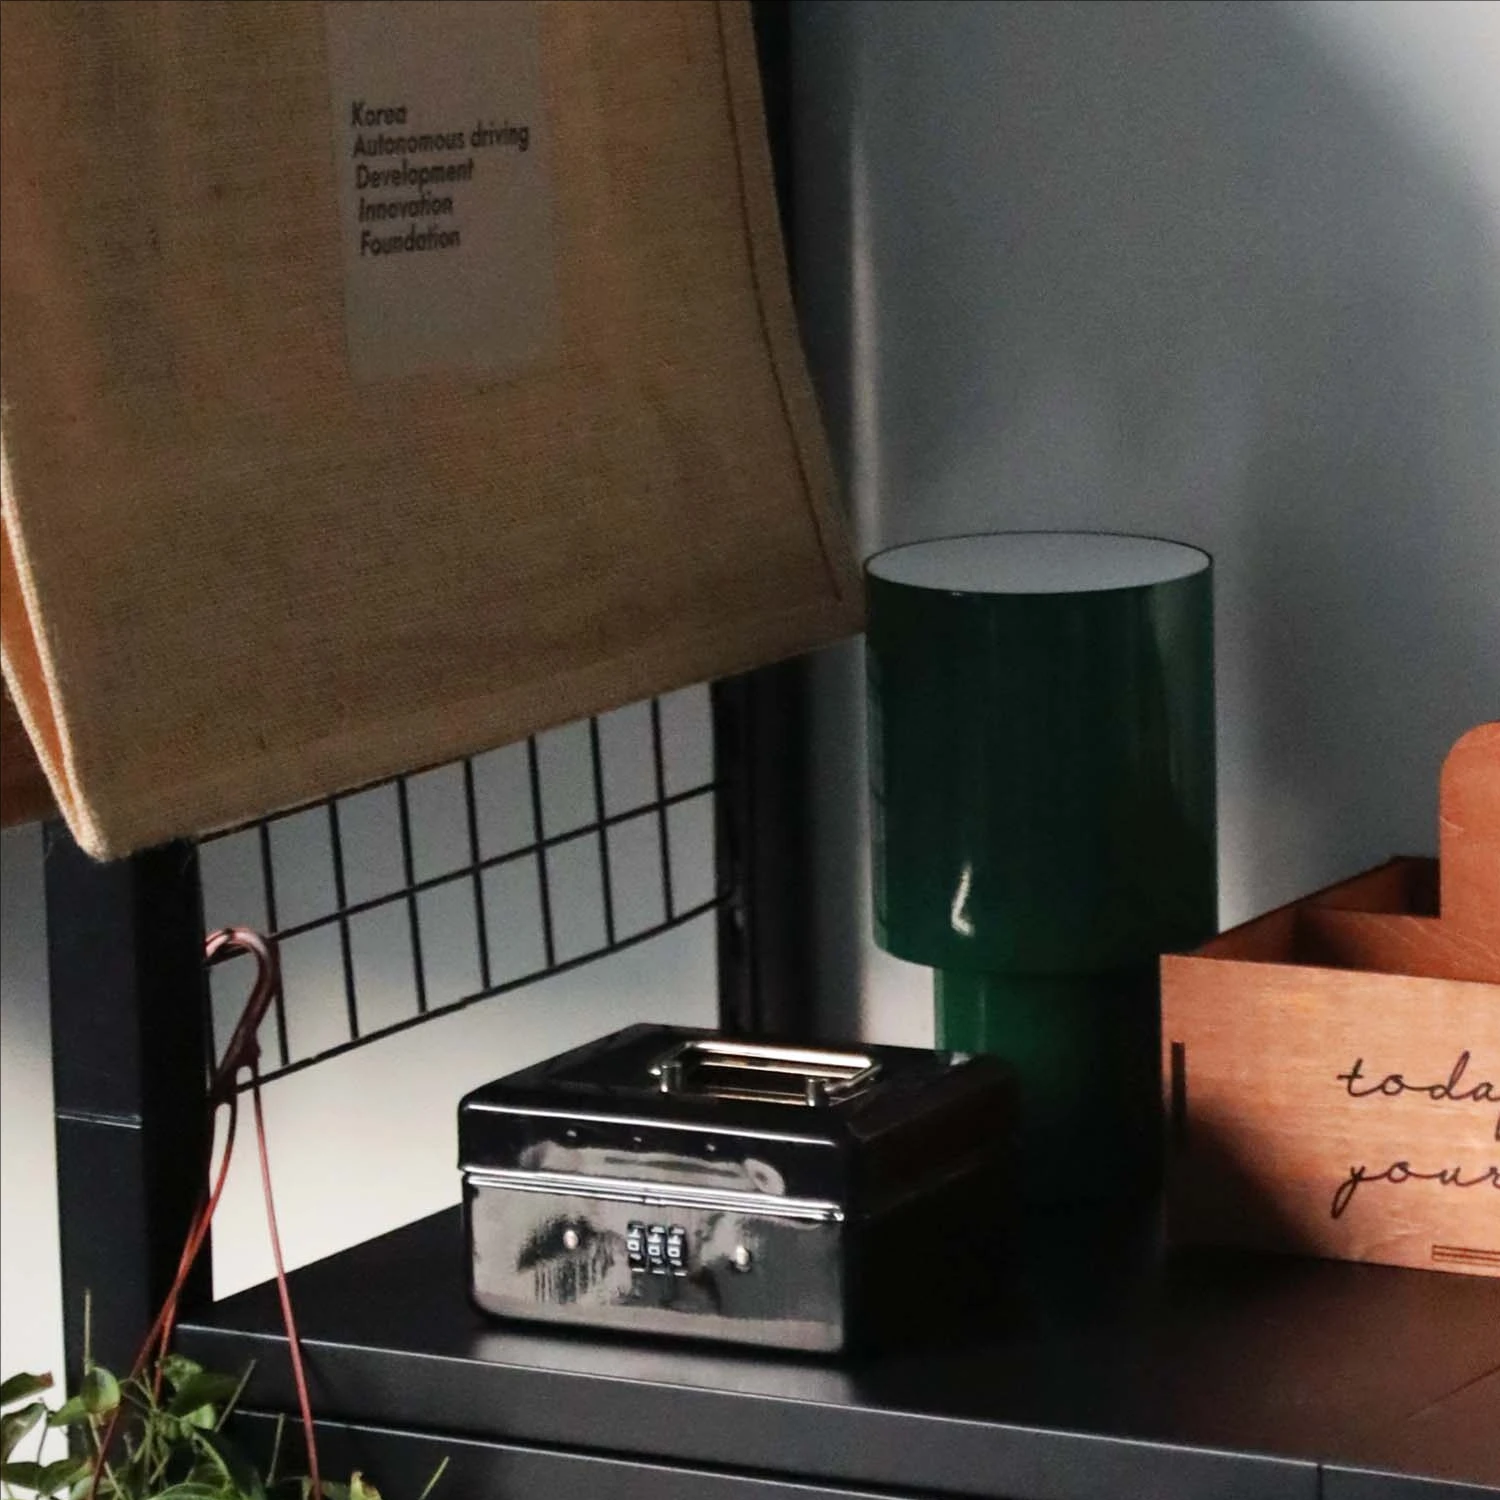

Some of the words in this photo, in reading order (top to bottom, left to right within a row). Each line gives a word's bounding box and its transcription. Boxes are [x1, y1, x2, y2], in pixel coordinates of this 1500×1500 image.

[351, 101, 408, 126] Korea
[353, 132, 465, 157] Autonomous
[470, 121, 529, 151] driving
[355, 158, 474, 193] Development
[358, 190, 454, 222] Innovation
[360, 224, 460, 255] Foundation
